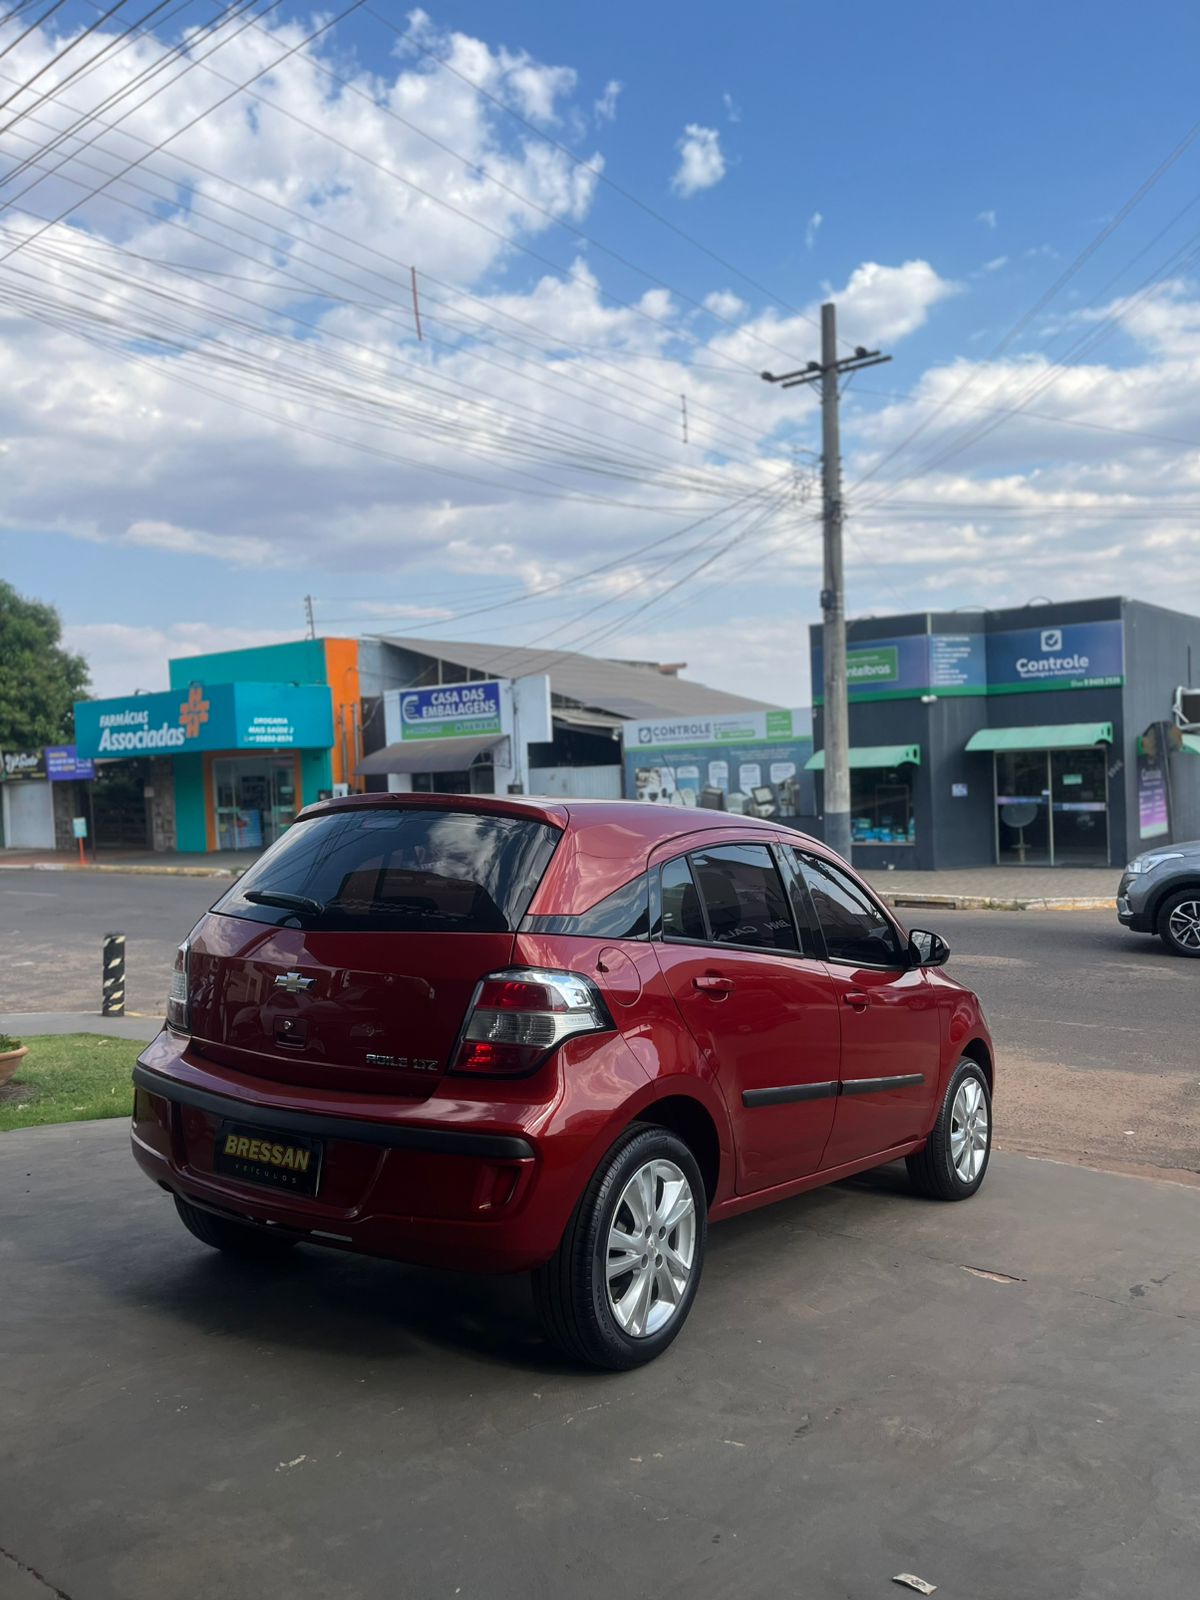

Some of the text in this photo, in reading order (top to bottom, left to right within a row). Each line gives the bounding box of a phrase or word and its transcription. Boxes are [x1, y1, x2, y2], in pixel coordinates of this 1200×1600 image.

[846, 664, 891, 677] ntelbras
[1016, 654, 1089, 673] Controle
[431, 687, 484, 705] CASA DAS
[422, 700, 497, 719] EMBALAGENS
[99, 710, 149, 728] FARMÁCIAS
[98, 722, 185, 752] Associadas
[653, 723, 711, 737] CONTROLE
[224, 1134, 310, 1172] BRESSAN
